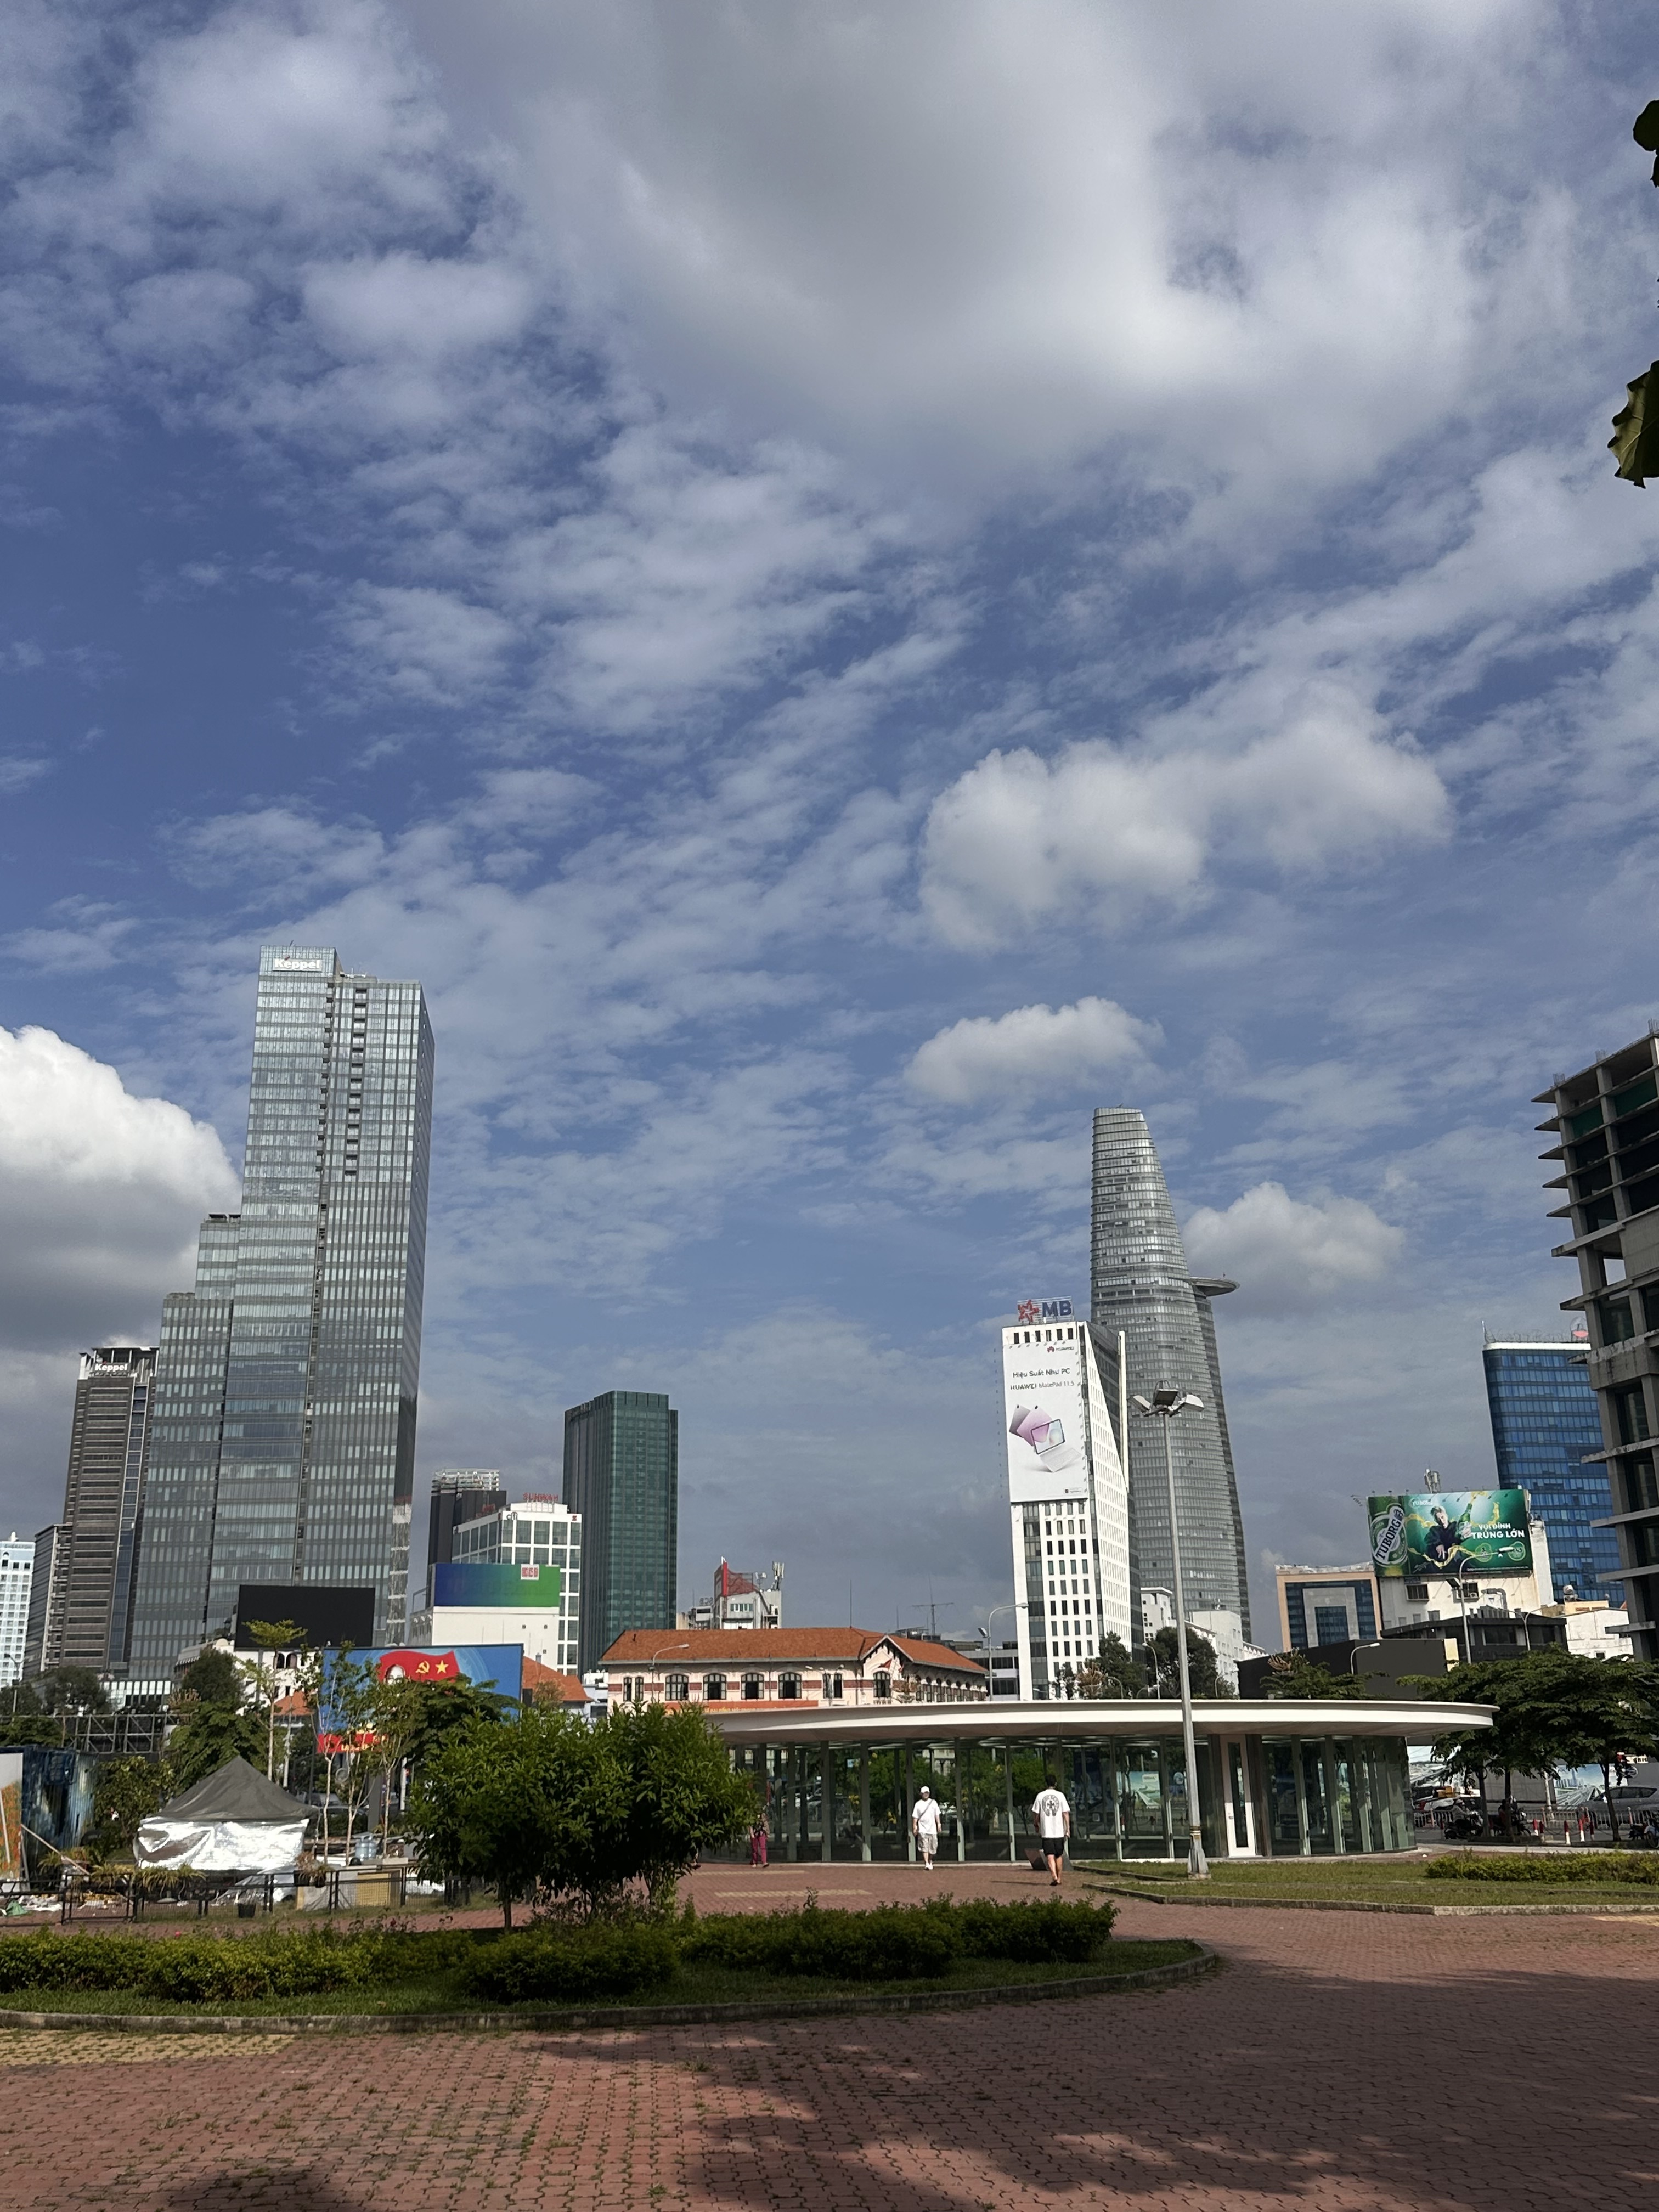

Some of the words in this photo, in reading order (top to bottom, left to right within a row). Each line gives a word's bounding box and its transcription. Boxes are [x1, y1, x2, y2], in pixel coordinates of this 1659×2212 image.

[274, 958, 320, 970] Keppel
[1042, 1300, 1071, 1317] MB
[95, 1363, 128, 1372] Keppel
[1029, 1368, 1044, 1376] Suất
[1375, 1518, 1401, 1560] TUBORG
